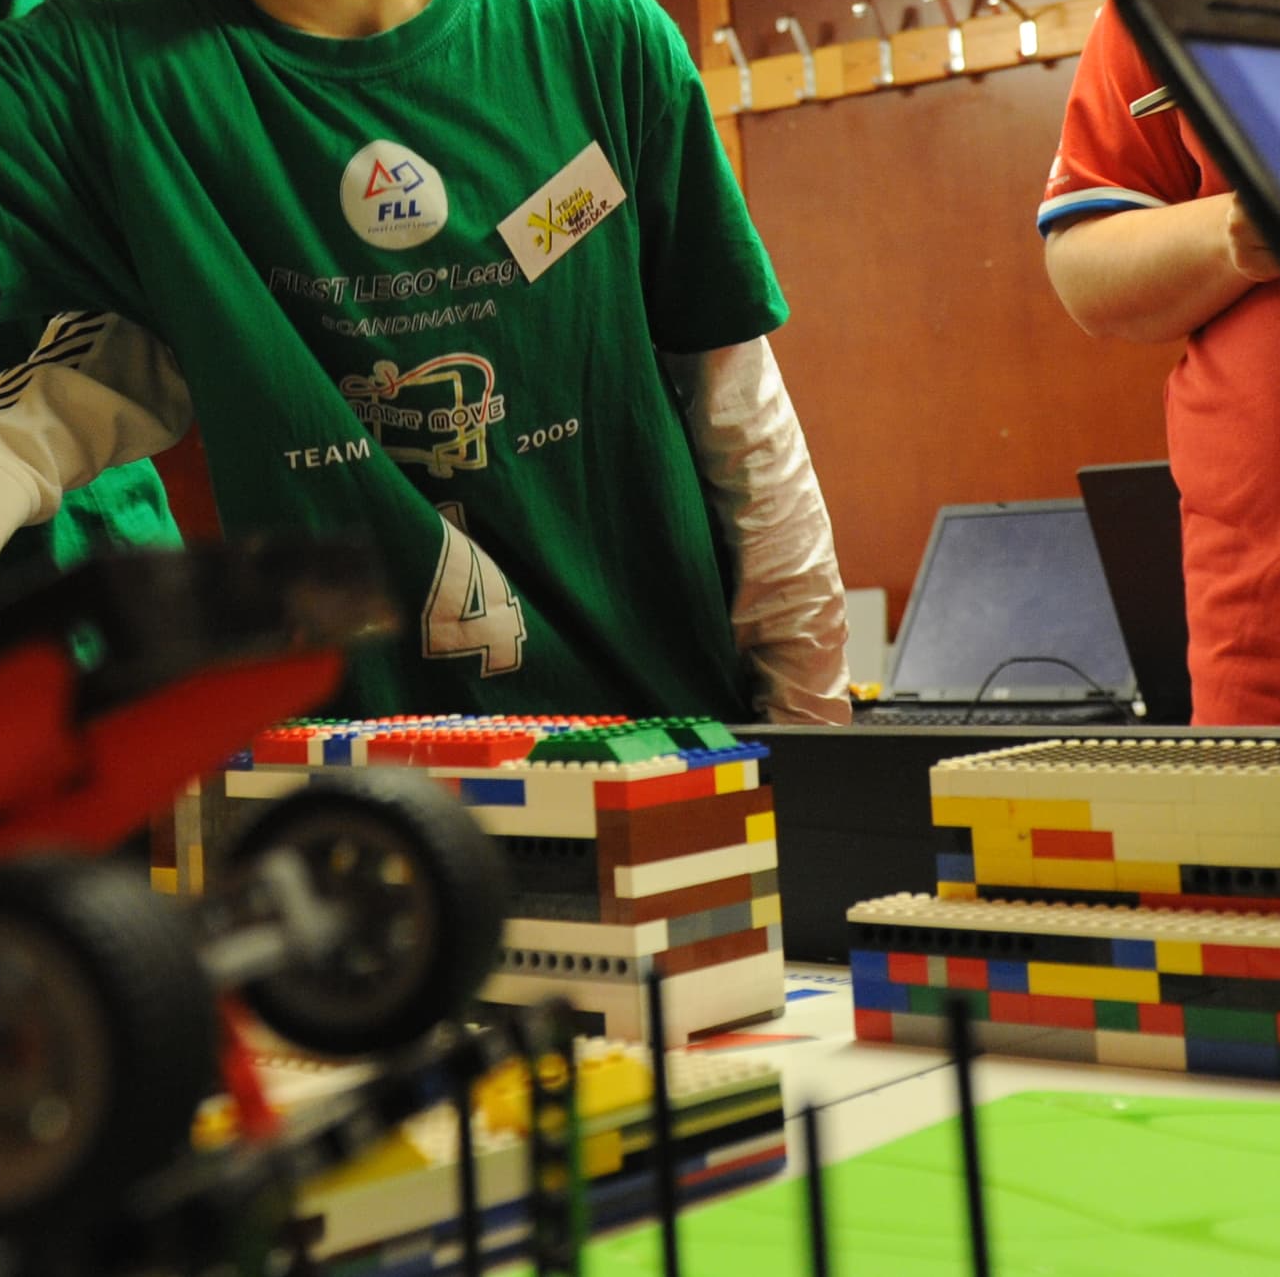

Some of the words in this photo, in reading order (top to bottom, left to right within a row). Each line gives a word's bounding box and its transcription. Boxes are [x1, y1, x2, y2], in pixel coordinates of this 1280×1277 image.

[378, 199, 421, 222] FLL
[270, 267, 349, 305] FIRST
[450, 258, 522, 290] Leag
[320, 298, 498, 338] SCANDINAVIA
[348, 400, 422, 430] MART
[429, 394, 506, 432] MOVE
[284, 437, 371, 469] TEAM
[516, 418, 579, 453] 2009
[421, 501, 527, 680] 4
